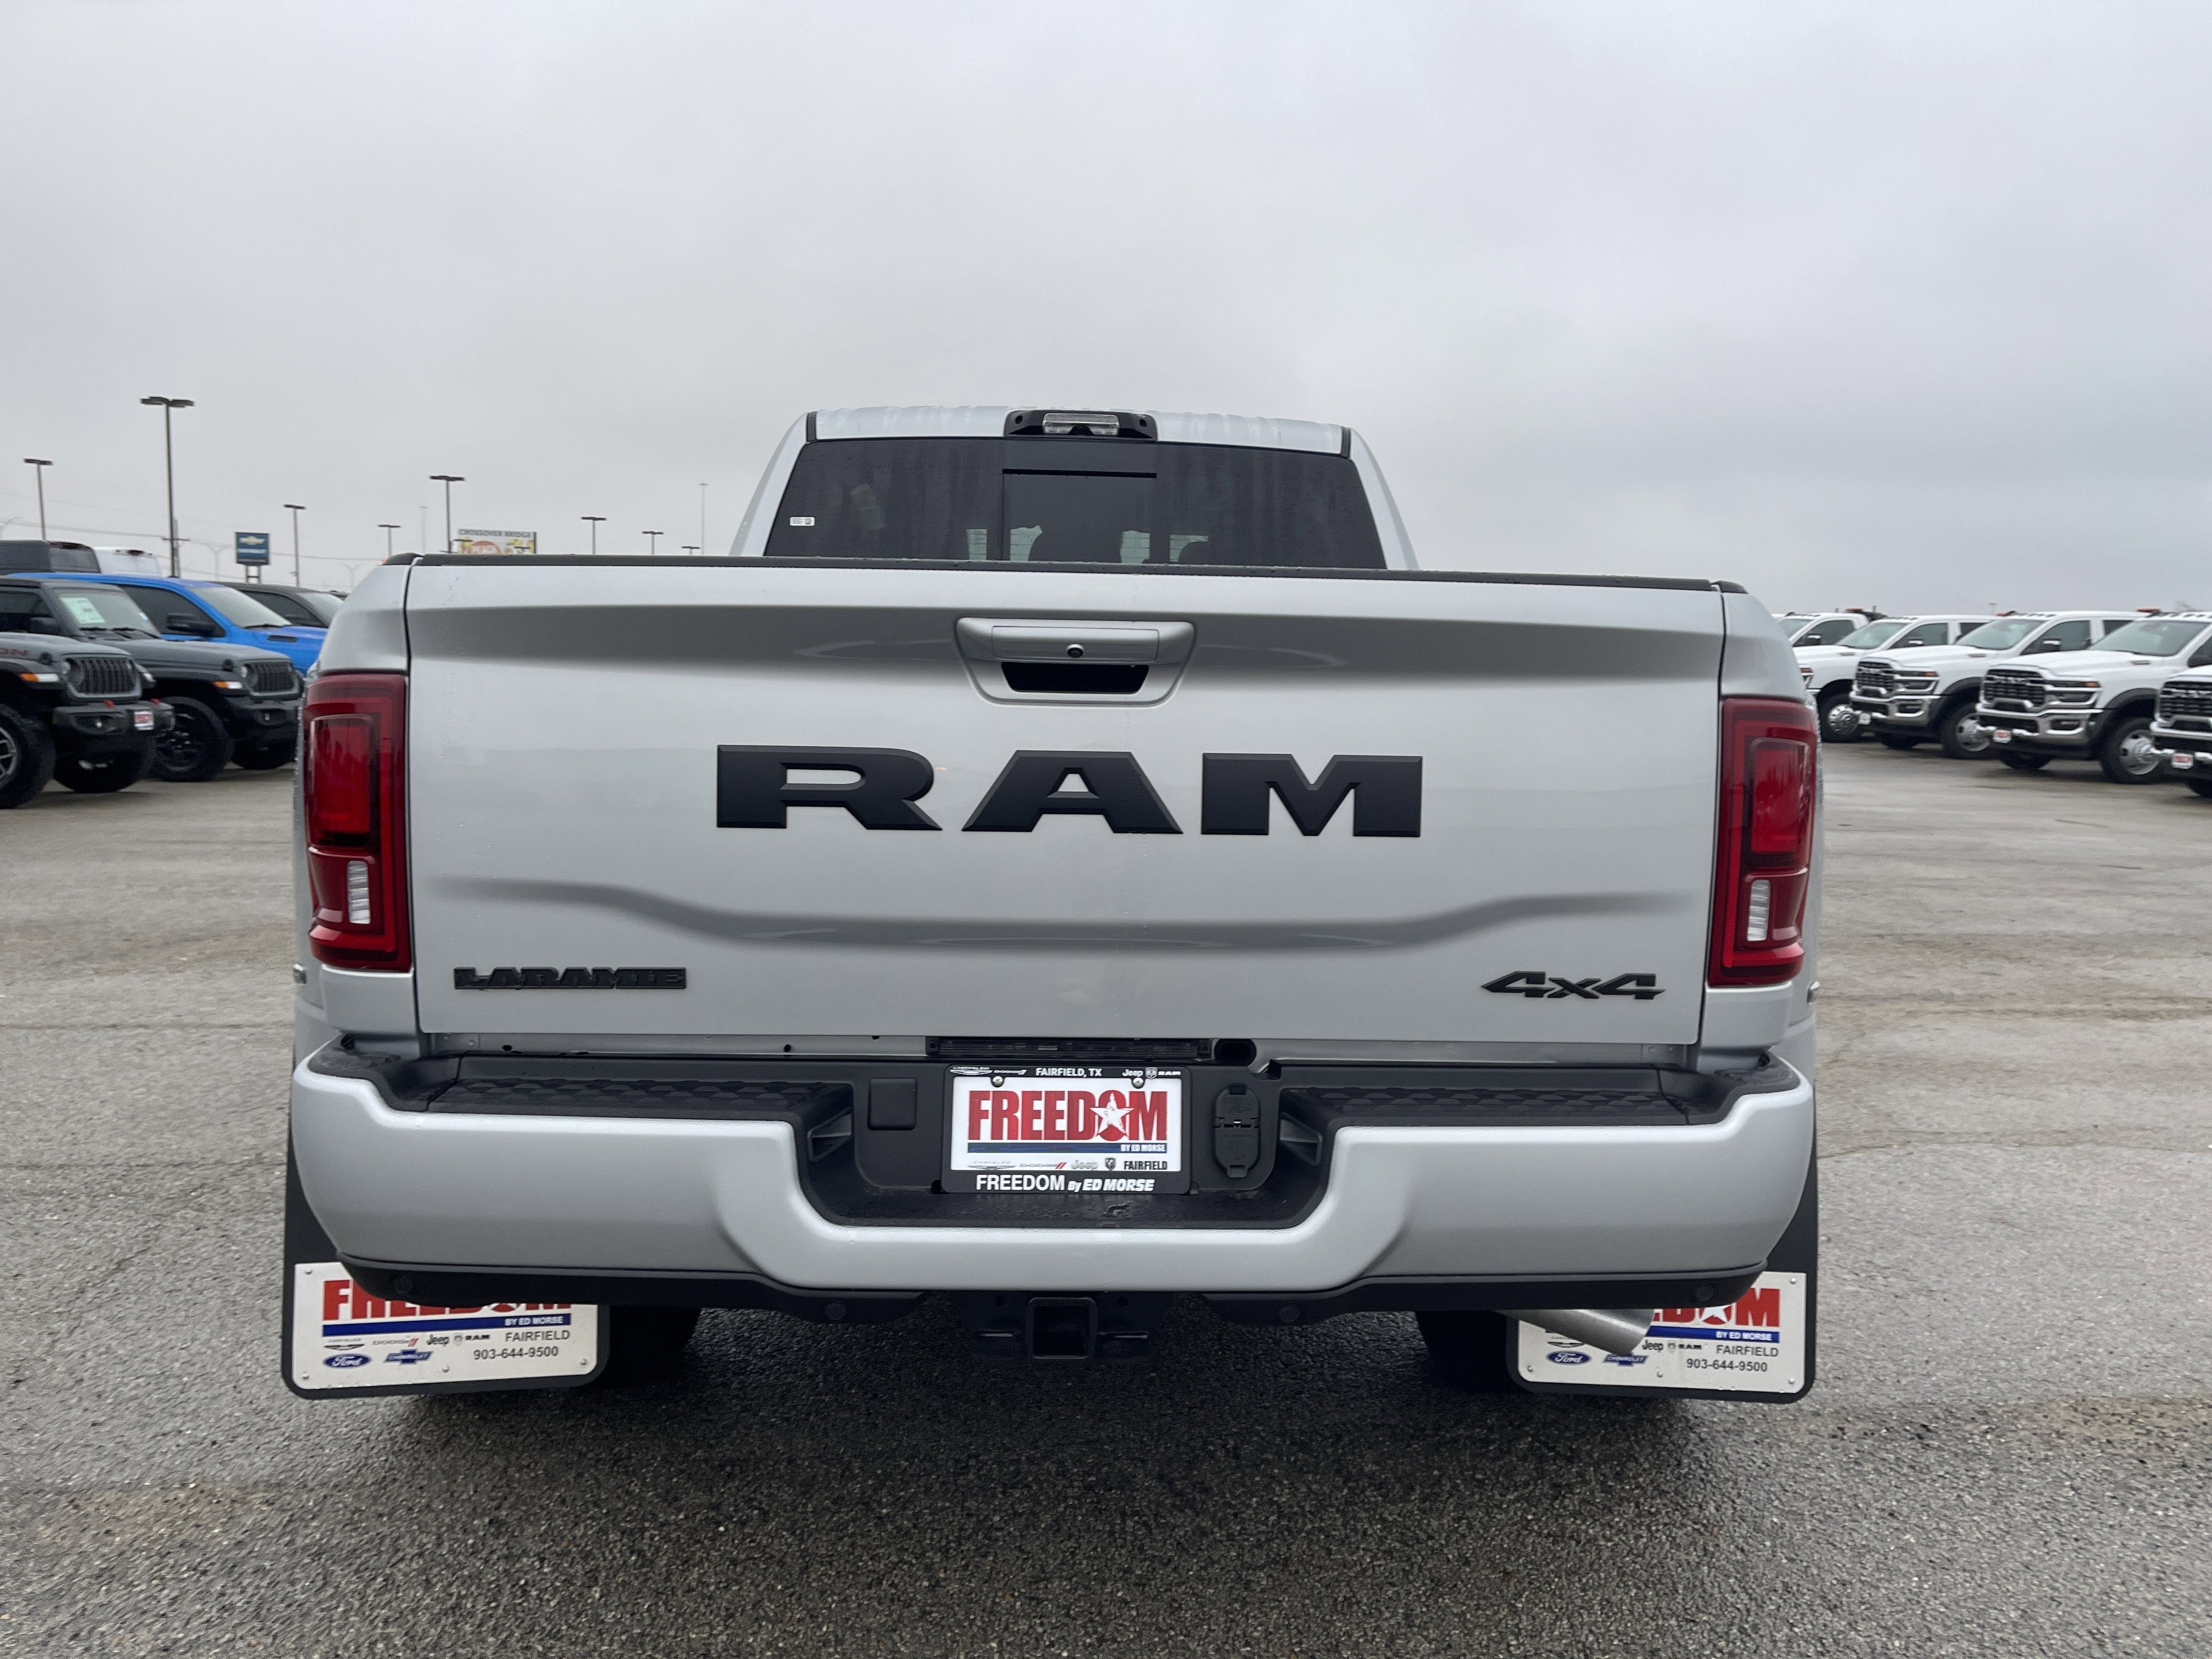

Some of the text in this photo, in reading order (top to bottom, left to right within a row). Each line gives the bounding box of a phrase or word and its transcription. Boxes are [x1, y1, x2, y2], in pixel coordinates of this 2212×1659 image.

[717, 744, 1423, 837] RAM
[454, 967, 686, 989] LARAMIE
[1480, 970, 1666, 1000] 4x4
[1036, 1068, 1102, 1077] FAIRFIELD, TX
[968, 1090, 1167, 1141] FREEDOM
[1071, 1160, 1098, 1171] Jeep
[1124, 1161, 1167, 1170] FAIRFIELD
[976, 1175, 1155, 1192] FREEDOM By ED MORSE
[532, 1316, 563, 1324] MORSE
[426, 1334, 449, 1346] Jeep
[505, 1330, 571, 1342] FAIRFIELD
[1742, 1333, 1772, 1341] MORSE
[1643, 1339, 1664, 1353] Jeep
[1716, 1344, 1779, 1357] FAIRFIELD
[473, 1346, 559, 1361] 903-644-9500
[1554, 1353, 1583, 1363] Ford
[331, 1356, 363, 1367] Ford
[1686, 1358, 1768, 1372] 903-644-9500
